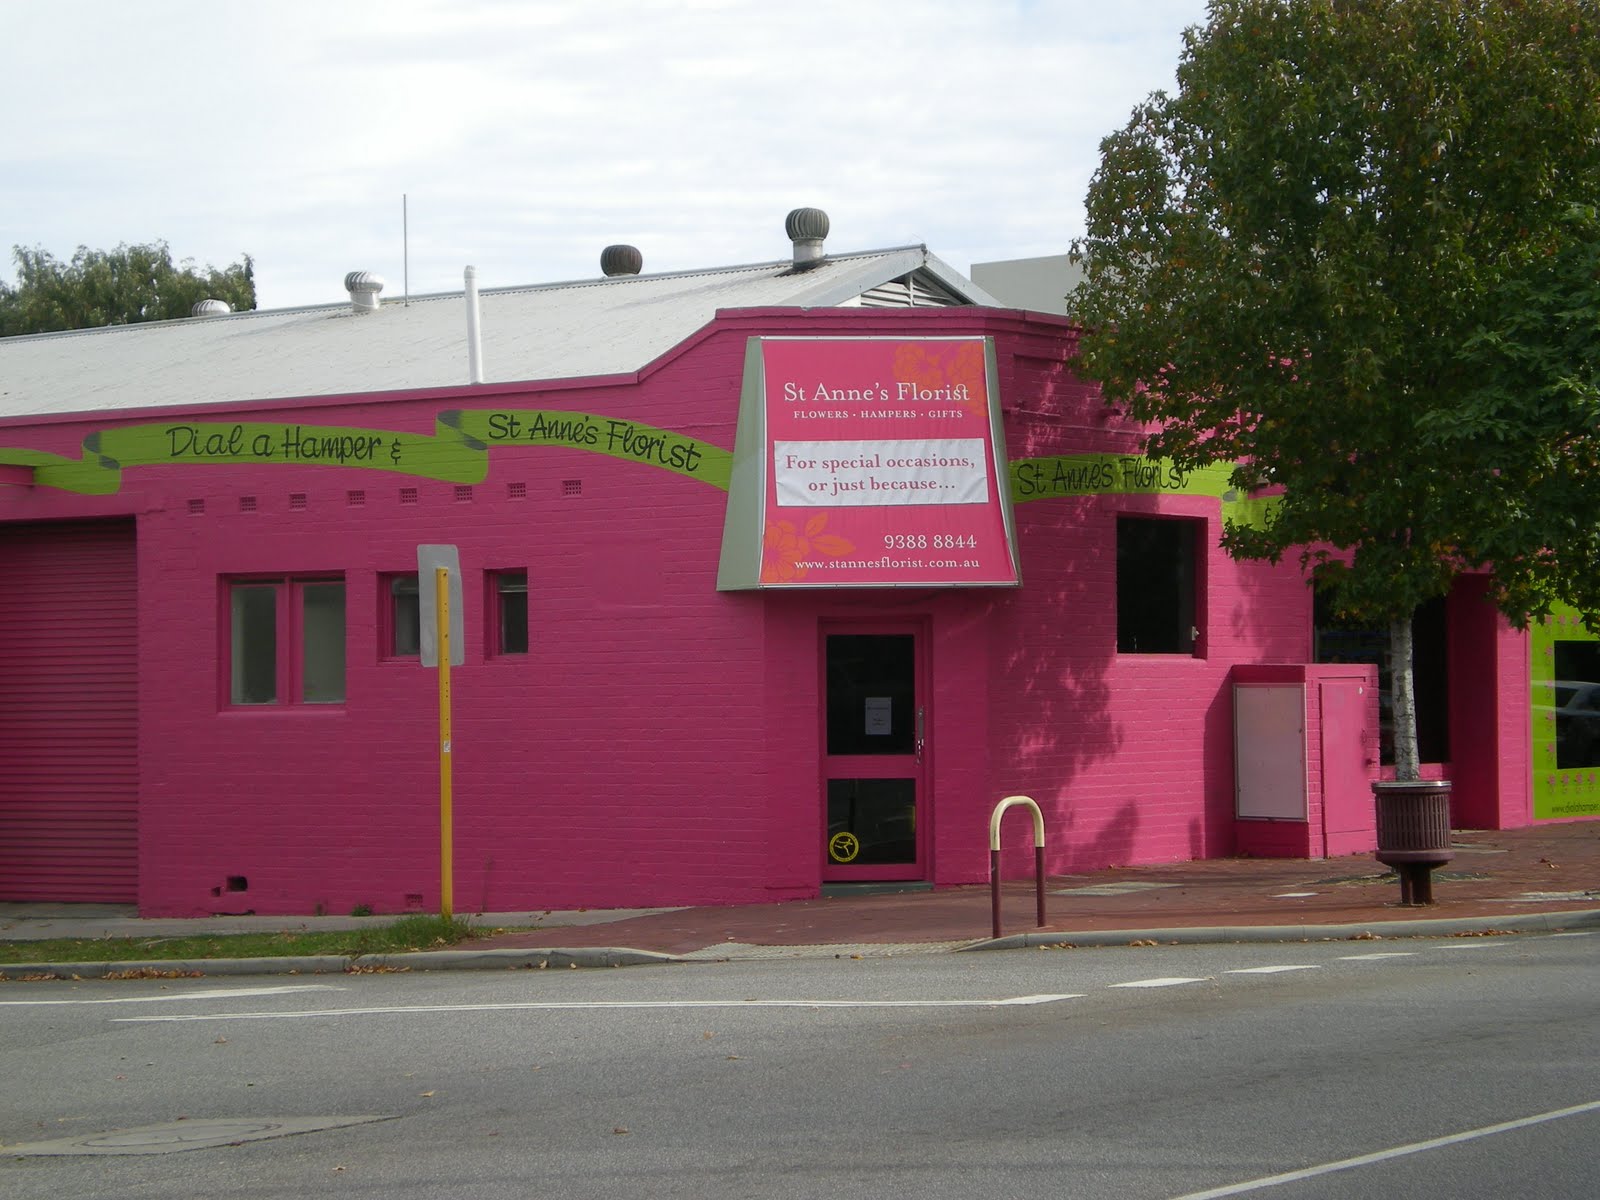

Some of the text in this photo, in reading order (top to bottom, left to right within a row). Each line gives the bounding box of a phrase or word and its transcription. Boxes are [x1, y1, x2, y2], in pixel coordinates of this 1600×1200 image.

[784, 382, 970, 401] St Anne's Florist
[793, 410, 964, 419] FLOWERS HAMPERS GIFTS
[165, 424, 402, 465] Dial a Hamper &
[488, 413, 521, 440] St
[606, 419, 702, 472] Florist
[785, 453, 976, 473] For special occasions,
[808, 480, 828, 491] or
[830, 477, 866, 496] just
[1016, 462, 1047, 496] St
[883, 534, 978, 549] 9388 8844
[794, 556, 981, 569] www.stannesflorist.com.au
